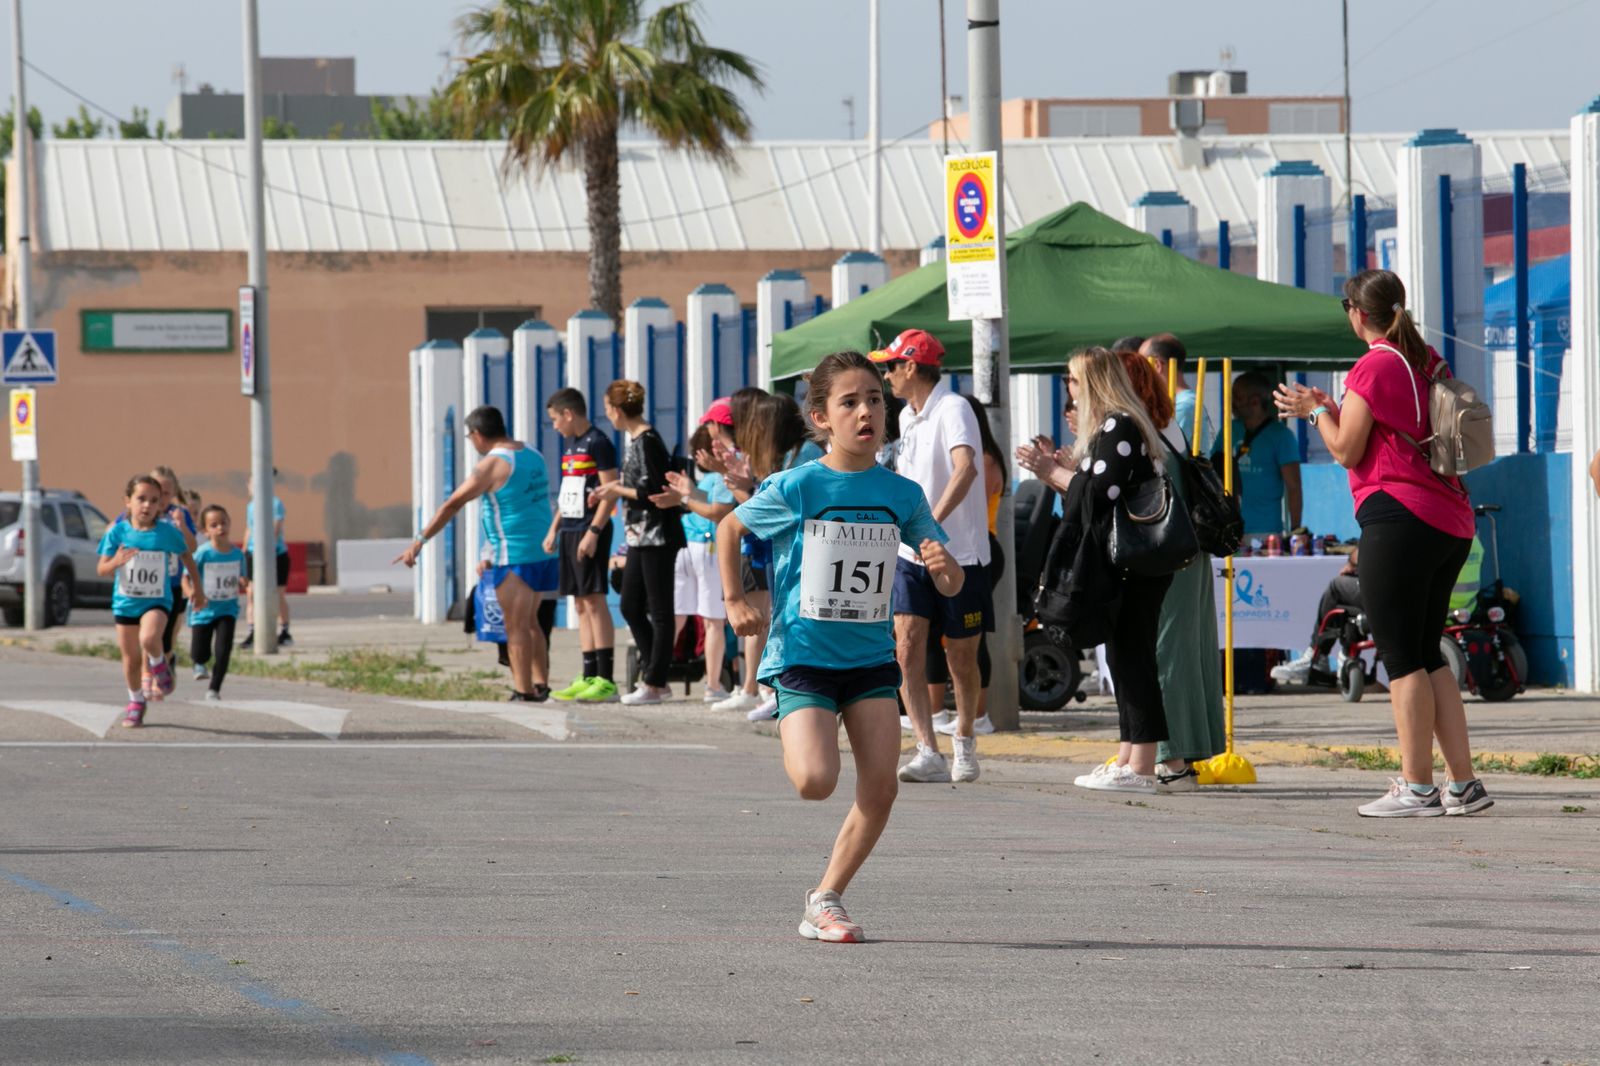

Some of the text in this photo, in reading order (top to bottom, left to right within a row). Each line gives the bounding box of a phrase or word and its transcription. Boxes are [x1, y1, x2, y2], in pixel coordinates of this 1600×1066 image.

[856, 513, 879, 521] C.A.L.
[813, 523, 898, 542] II MILLA
[128, 568, 159, 585] 106
[828, 559, 886, 595] 151
